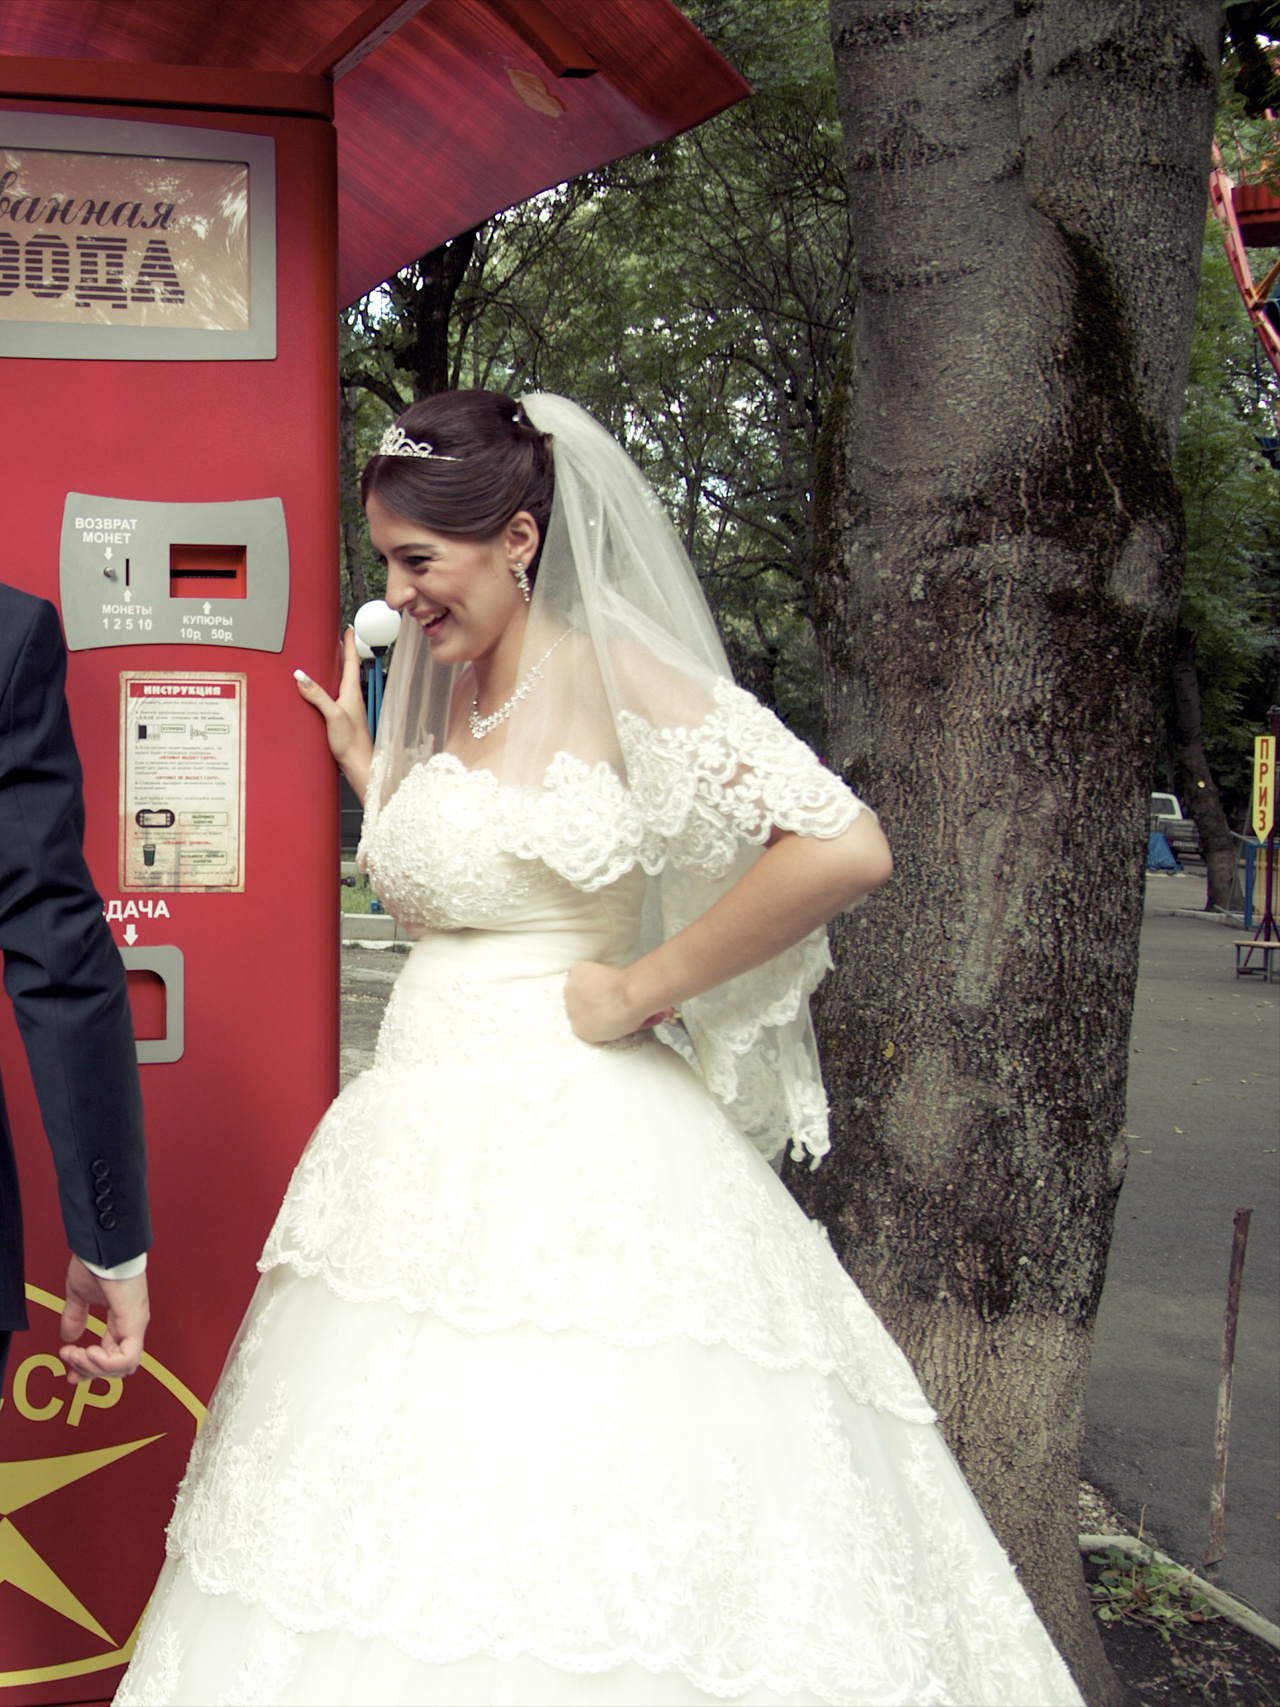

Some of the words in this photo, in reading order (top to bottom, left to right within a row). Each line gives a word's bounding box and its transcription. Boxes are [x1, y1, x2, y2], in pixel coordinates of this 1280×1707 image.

[74, 517, 138, 531] ВОЗВРАТ
[82, 531, 131, 545] МОНЕТ
[102, 604, 153, 616] МОНЕТЫ
[102, 618, 109, 630] 1
[113, 618, 121, 630] 2
[125, 619, 133, 630] 5
[137, 619, 153, 631] 10
[182, 615, 234, 627] КУПЮРЫ
[180, 628, 202, 642] 10р.
[210, 629, 234, 643] 50р.
[143, 685, 221, 697] ИНСТРУКЦИЯ
[1258, 738, 1270, 832] ПРИЗ
[101, 899, 170, 922] ДАЧА
